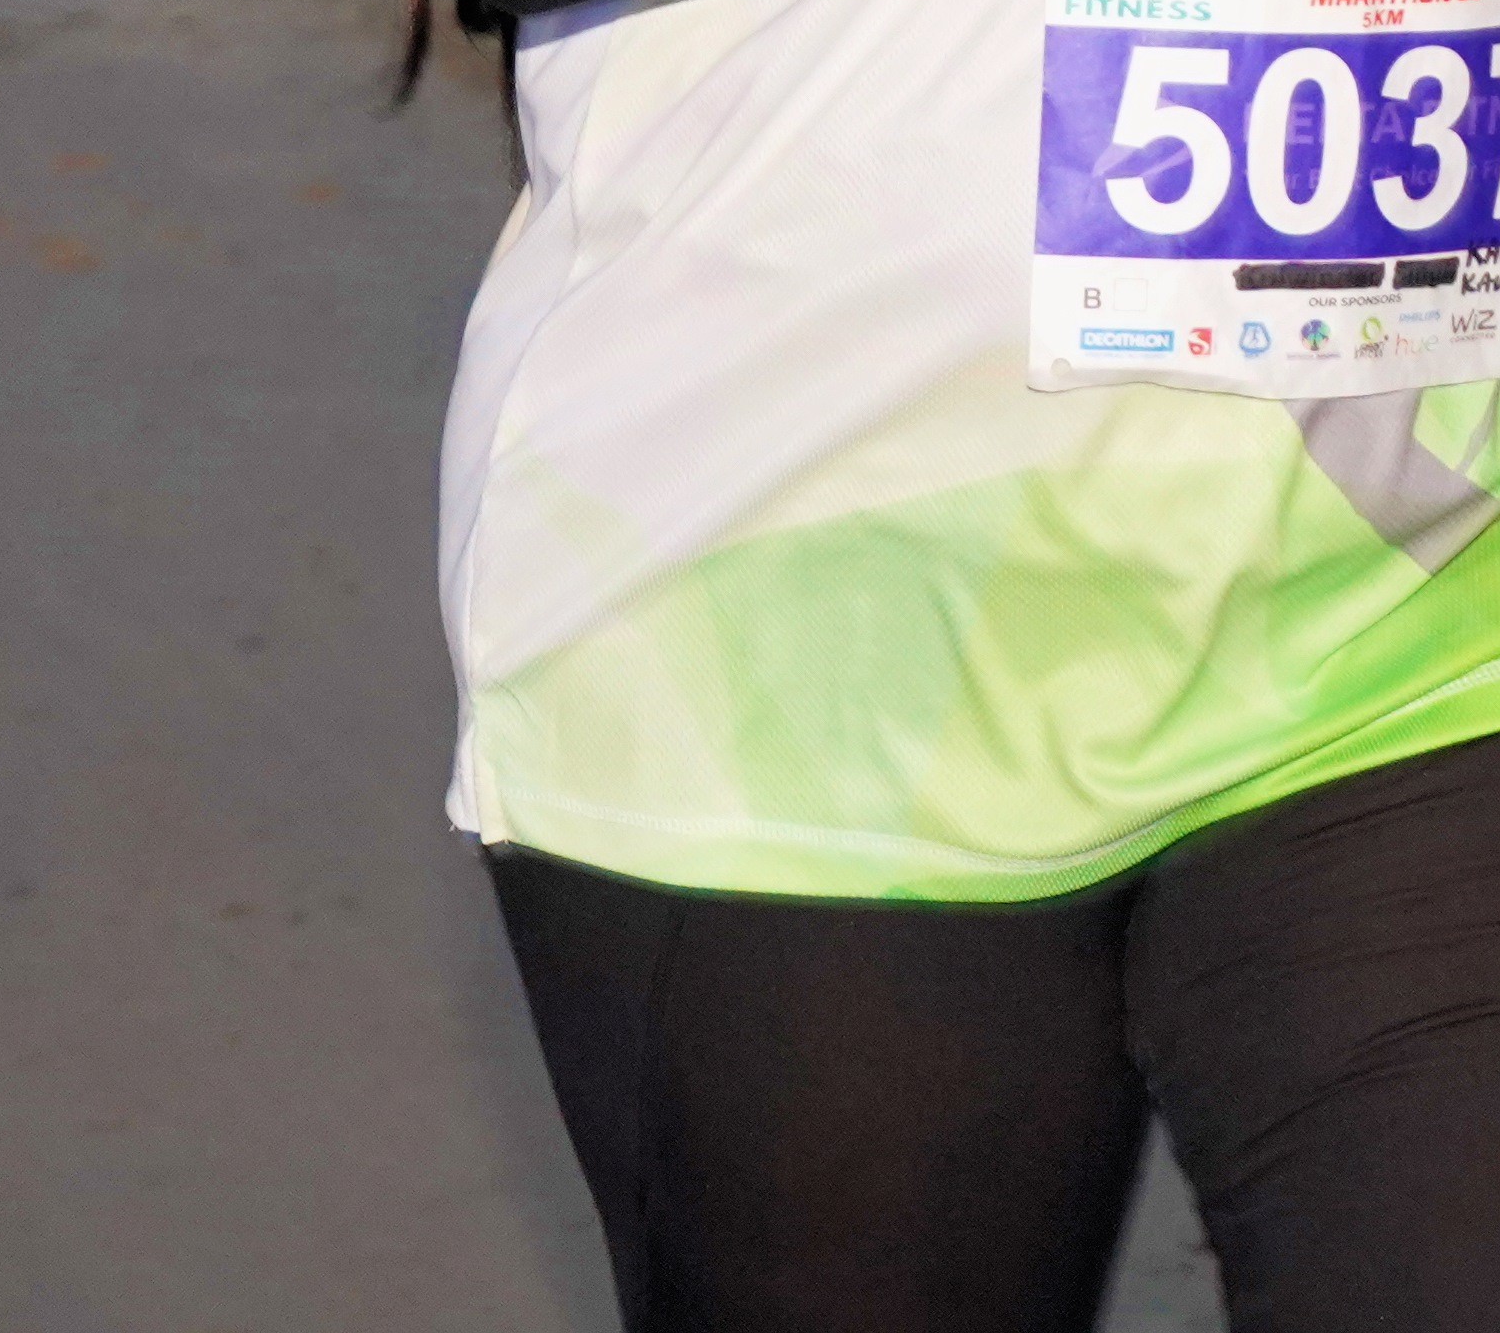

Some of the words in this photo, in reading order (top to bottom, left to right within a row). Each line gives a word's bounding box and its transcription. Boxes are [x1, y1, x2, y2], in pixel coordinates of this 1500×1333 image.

[1083, 288, 1102, 309] B
[1309, 296, 1338, 307] OUR
[1341, 293, 1403, 307] SPONSORS
